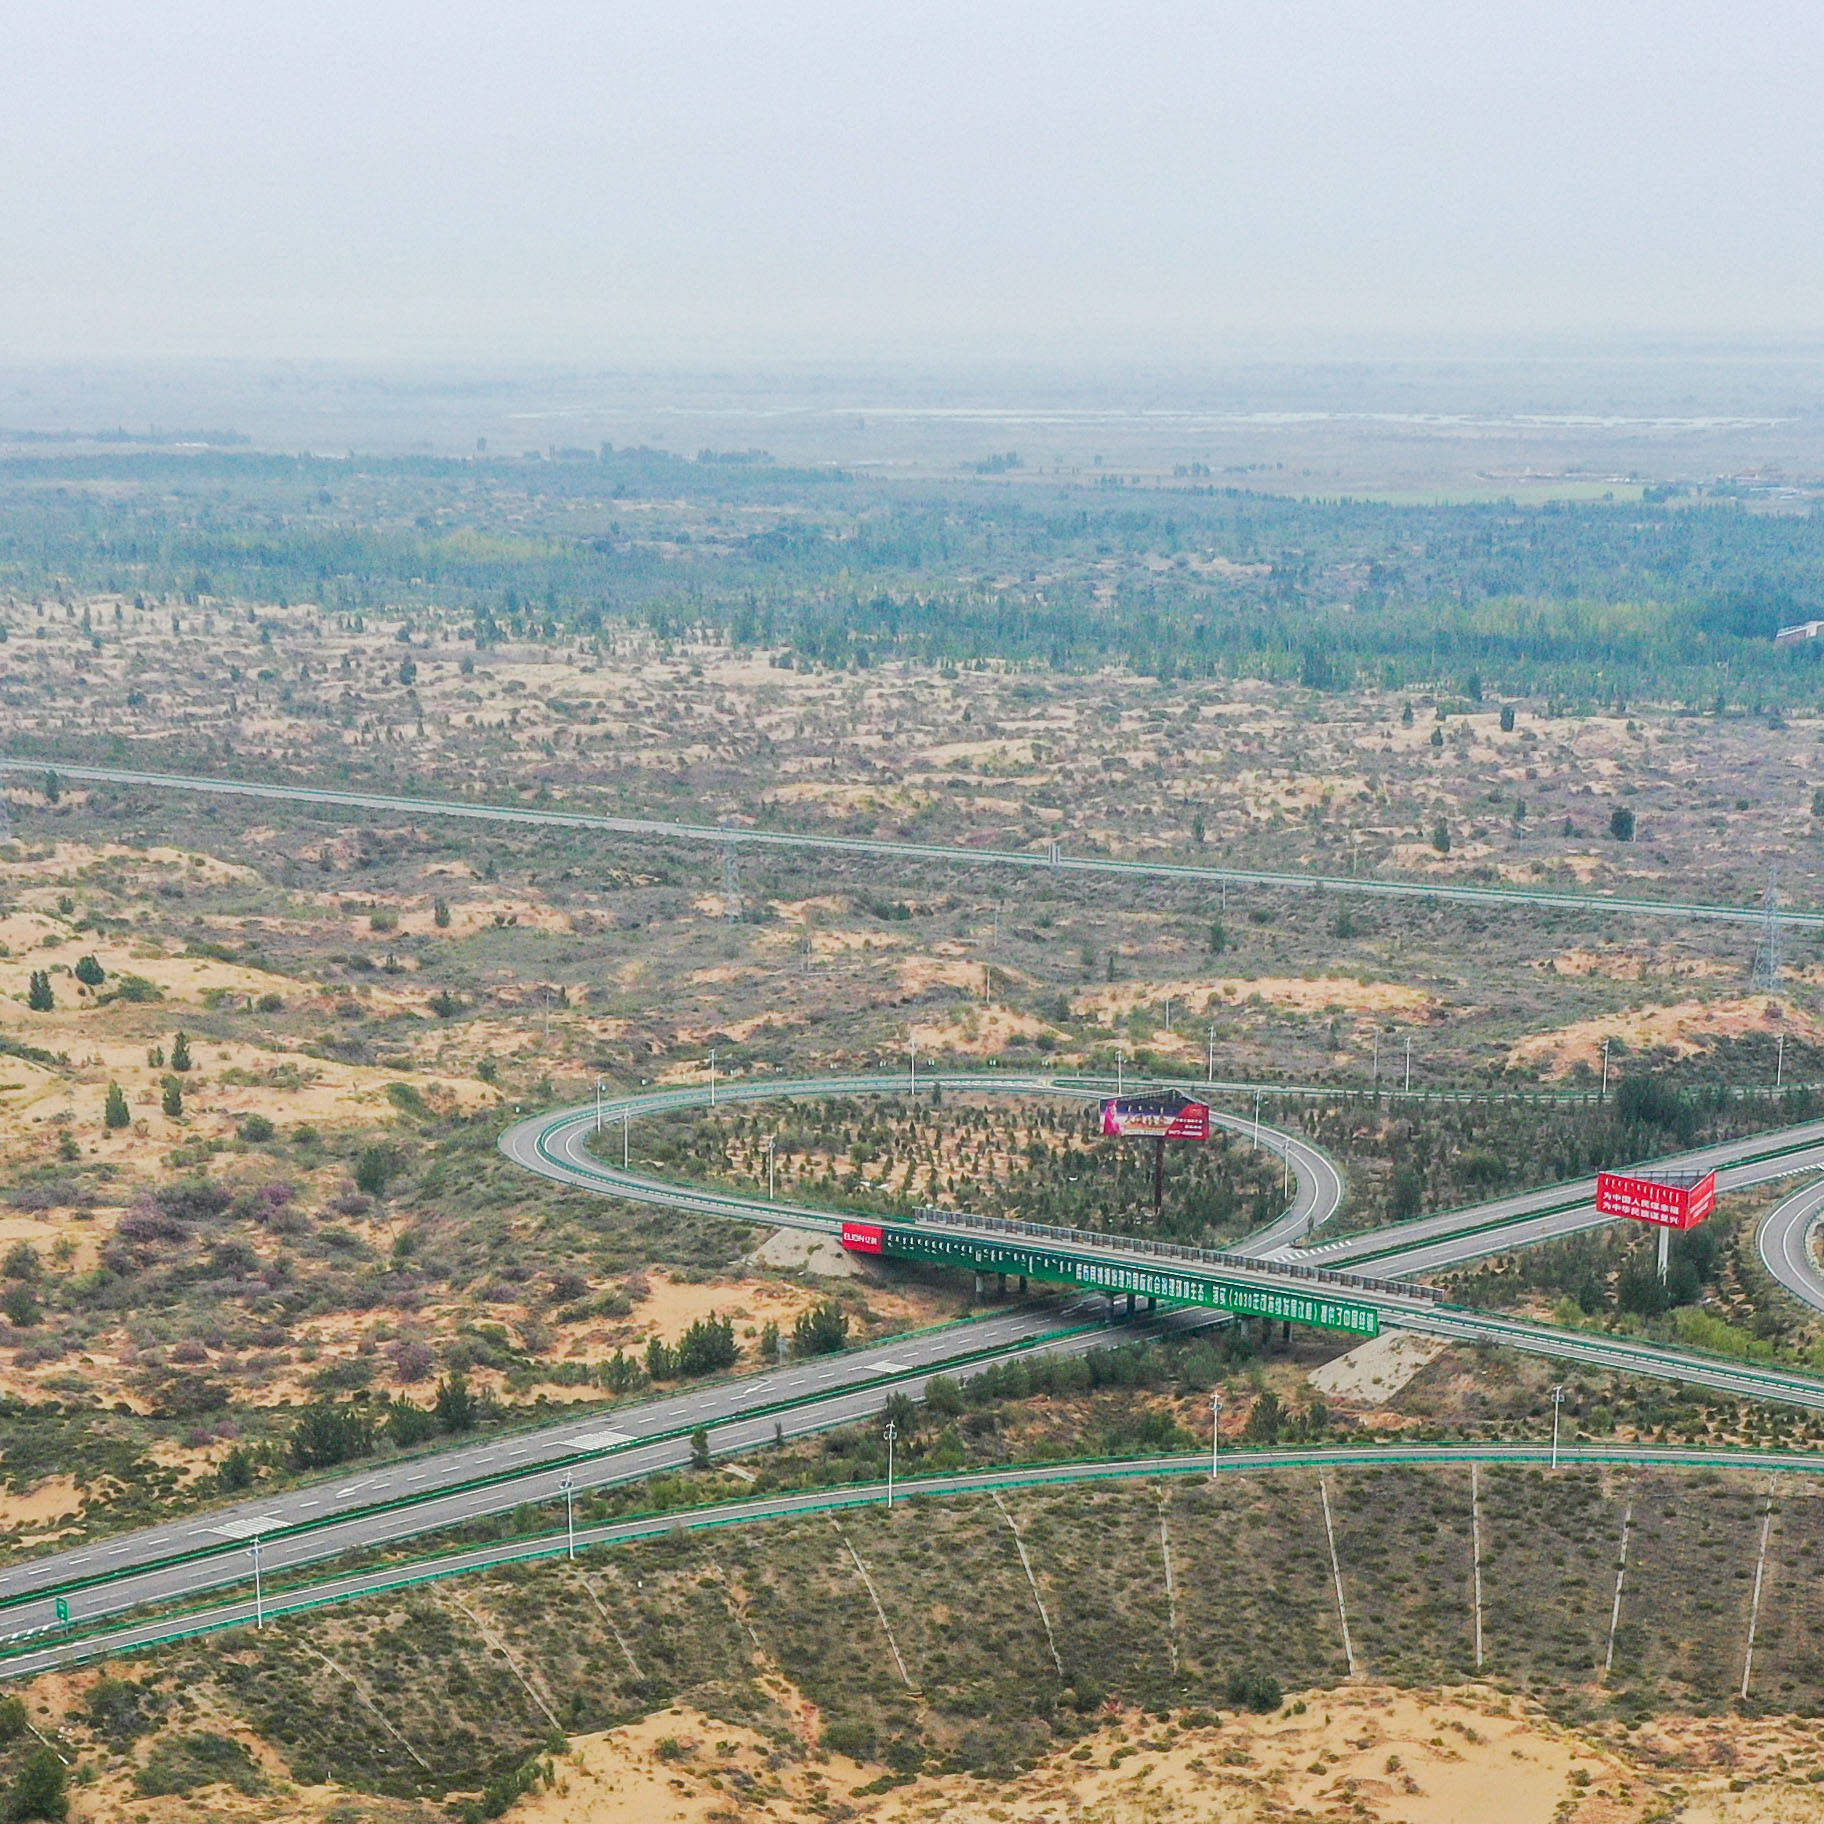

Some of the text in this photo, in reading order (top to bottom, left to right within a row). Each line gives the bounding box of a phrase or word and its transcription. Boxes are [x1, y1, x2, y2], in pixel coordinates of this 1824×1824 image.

[1602, 1191, 1680, 1215] 为中国人民谋幸福
[1602, 1201, 1679, 1225] 为中华民族谋复兴
